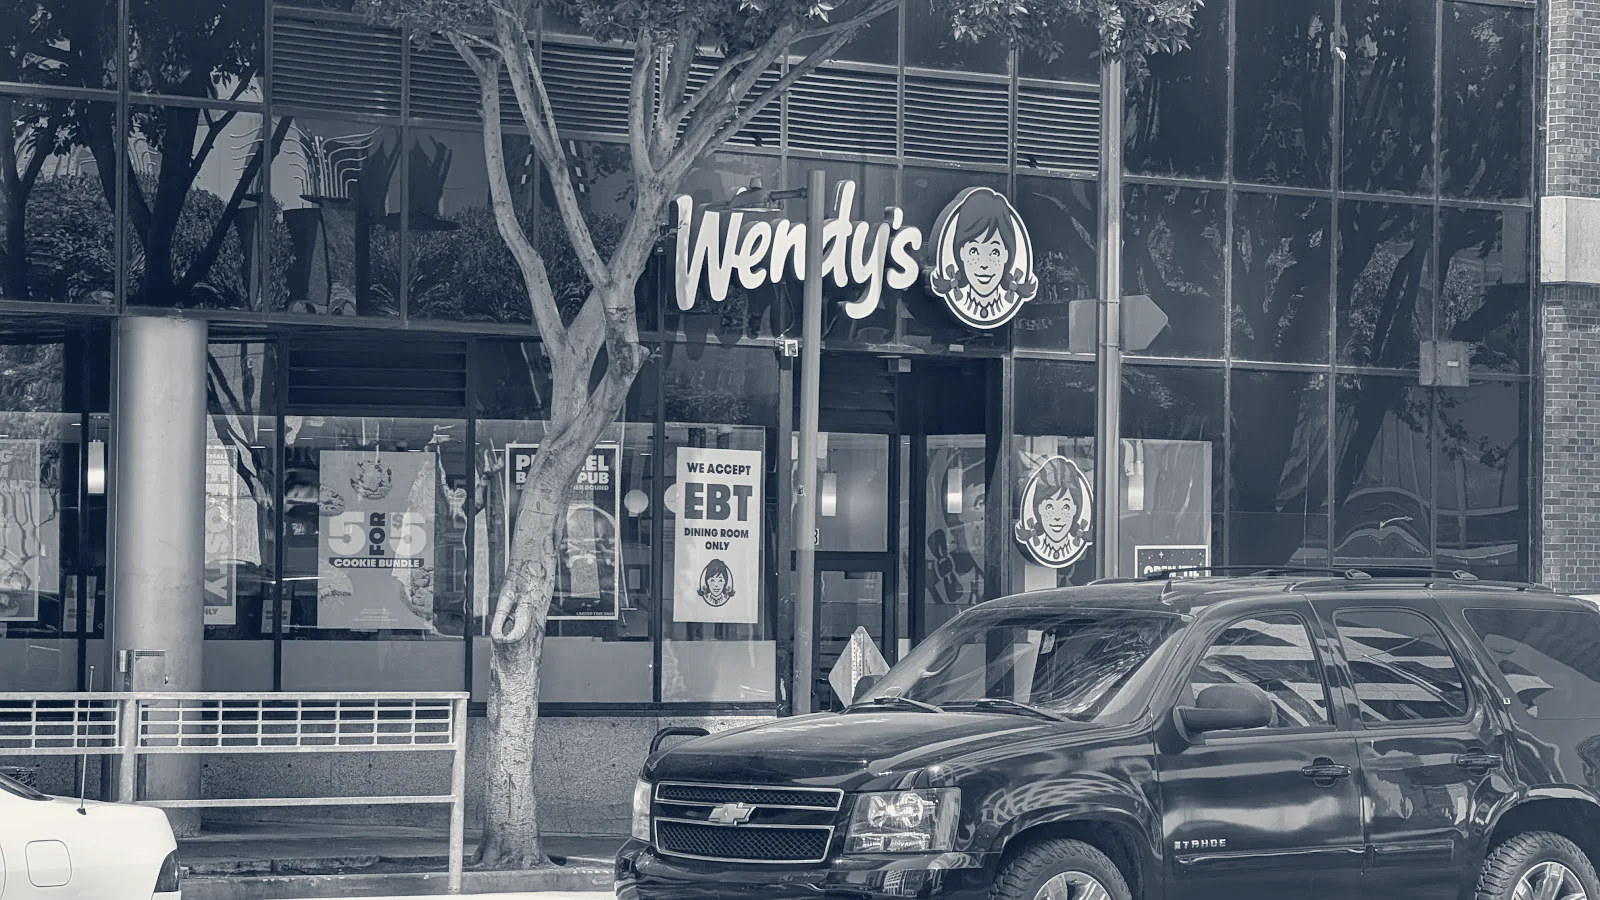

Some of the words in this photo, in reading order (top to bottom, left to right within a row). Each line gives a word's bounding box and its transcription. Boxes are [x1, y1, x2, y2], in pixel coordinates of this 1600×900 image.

[675, 180, 923, 320] Wendy's
[686, 462, 705, 474] WE
[706, 463, 751, 476] ACCEPT
[577, 472, 609, 484] PUB
[684, 482, 753, 522] EBT
[327, 511, 366, 556] 5
[368, 512, 386, 556] FOR
[684, 527, 718, 538] DINING
[720, 528, 749, 539] ROOM
[705, 540, 730, 551] ONLY
[333, 558, 377, 568] COOKIE
[378, 558, 420, 568] BUNDLE
[203, 608, 219, 616] NLY
[1182, 838, 1227, 849] TAHOE
